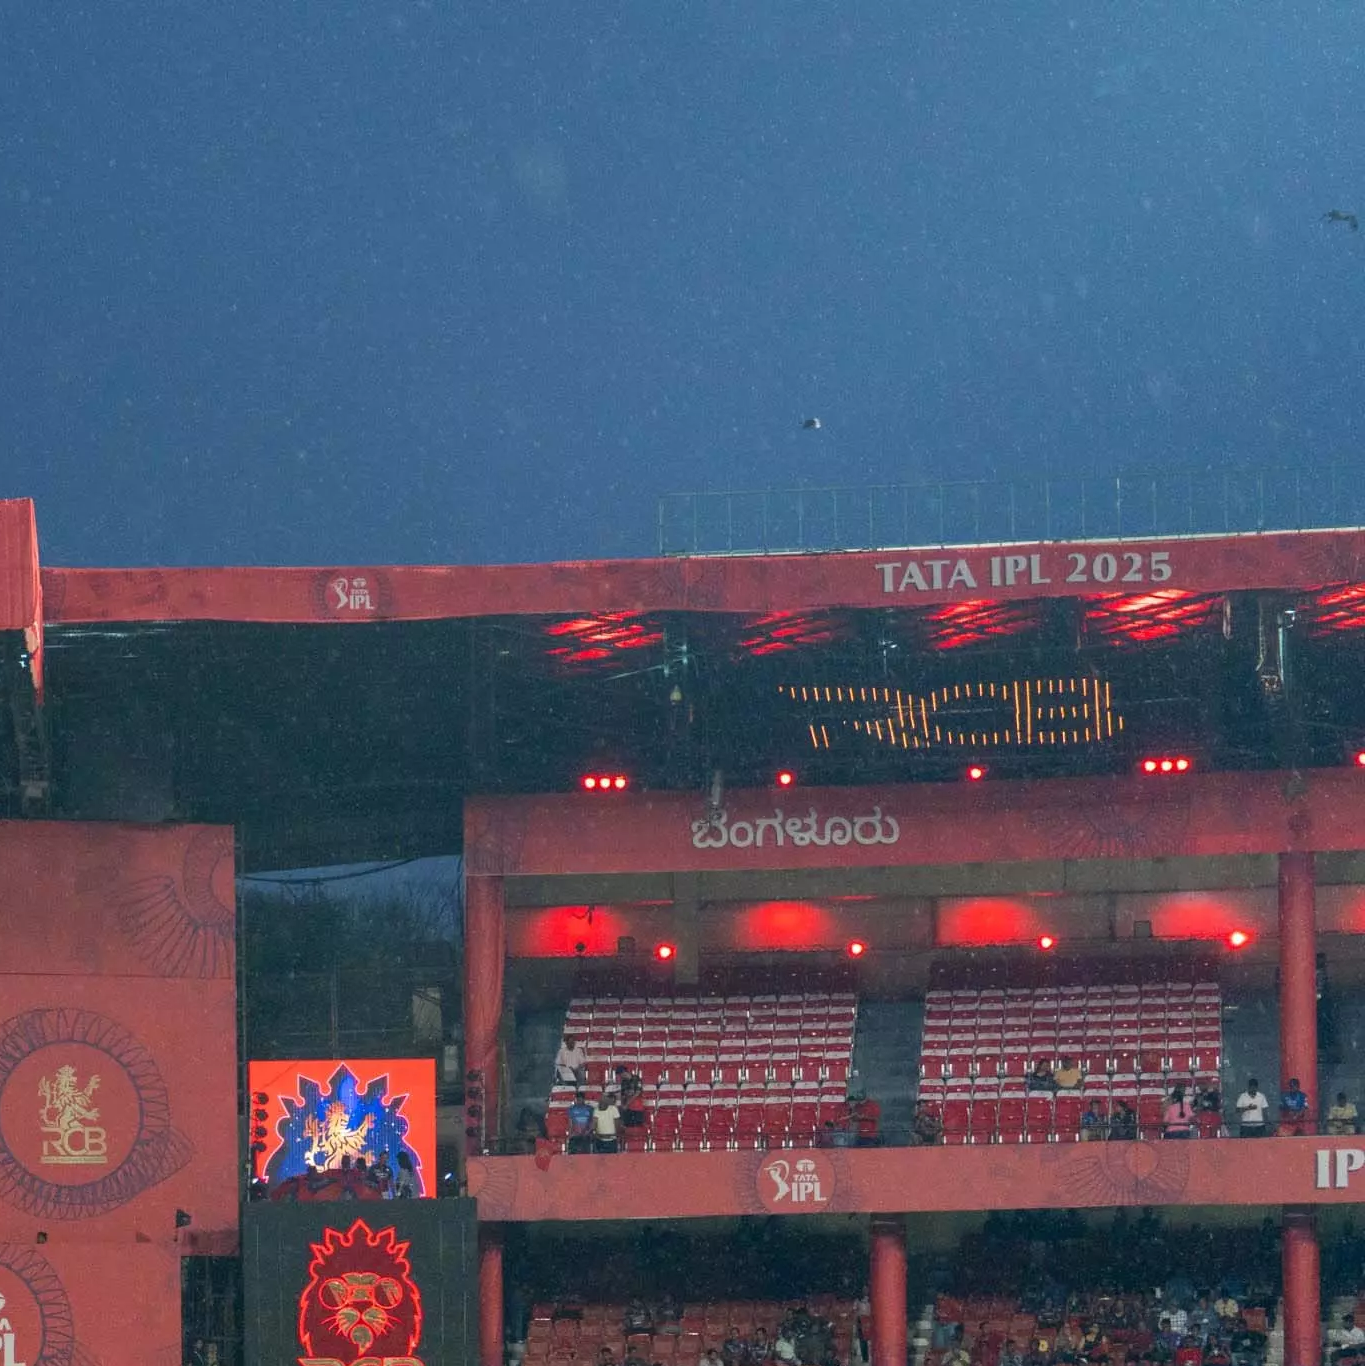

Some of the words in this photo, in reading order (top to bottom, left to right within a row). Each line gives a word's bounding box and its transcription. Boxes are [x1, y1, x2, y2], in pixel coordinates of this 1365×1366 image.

[876, 559, 977, 593] TATA
[991, 554, 1050, 587] IPL
[1067, 551, 1173, 583] 2025
[348, 595, 375, 610] IPL
[40, 1127, 108, 1155] RCB
[792, 1174, 819, 1182] TATA
[790, 1183, 827, 1202] IPL
